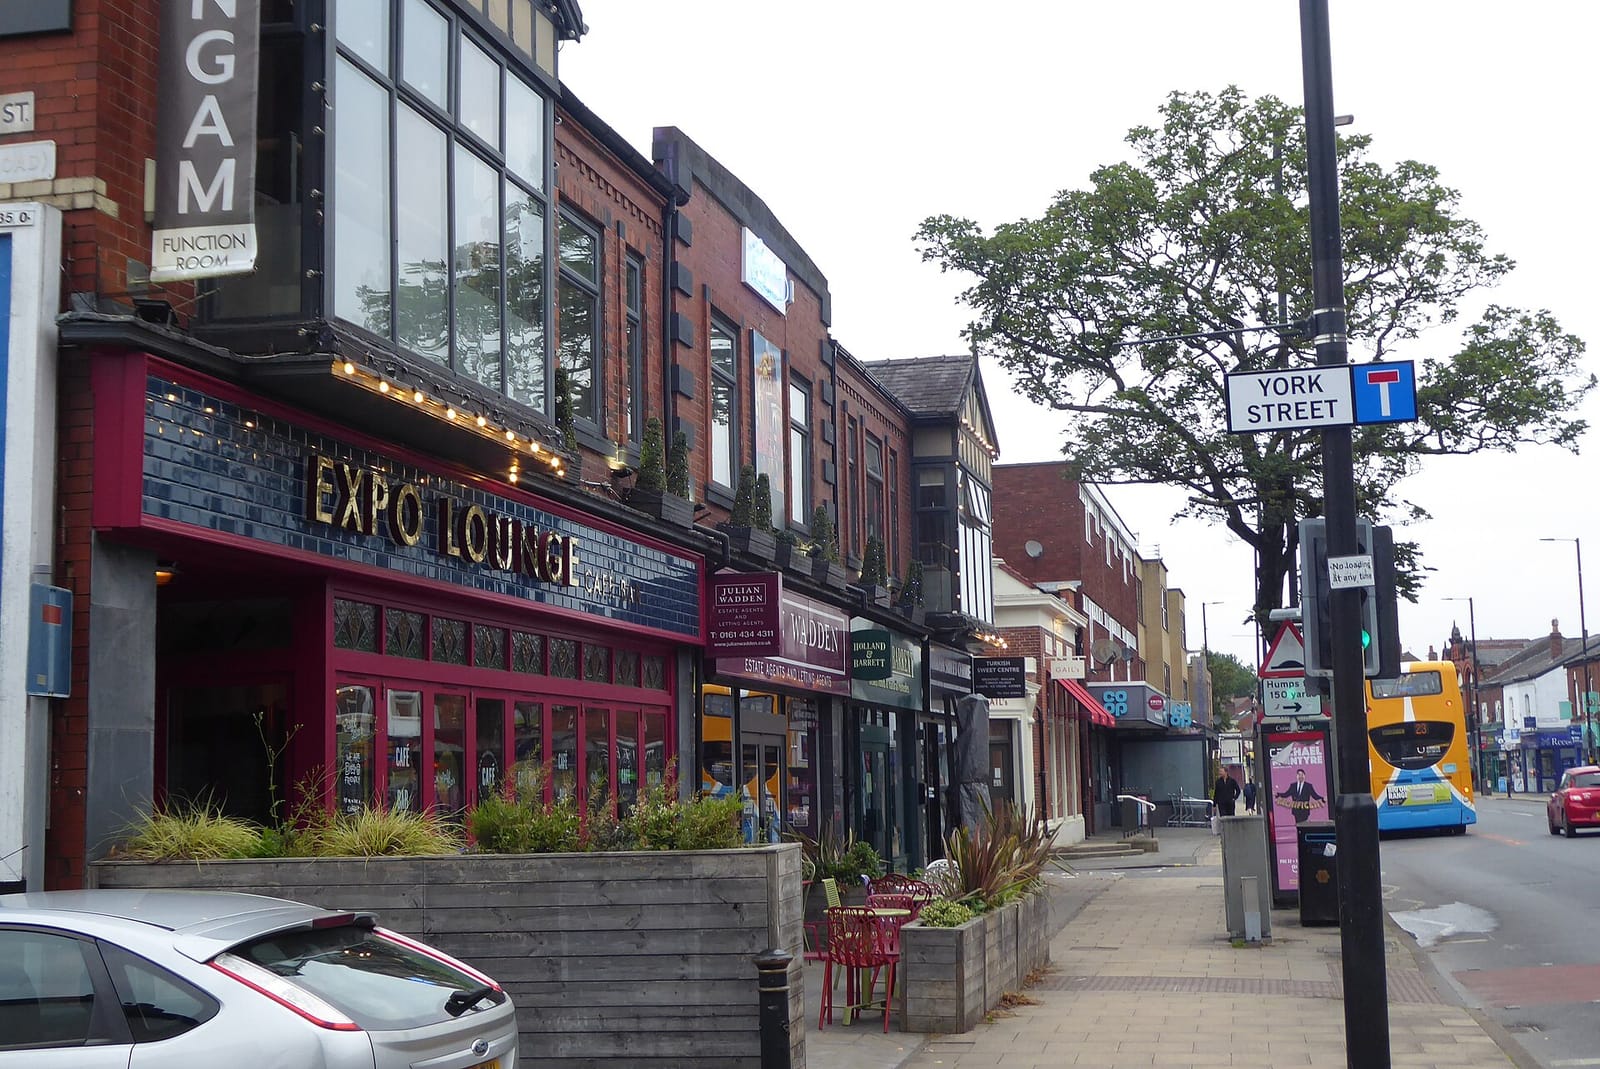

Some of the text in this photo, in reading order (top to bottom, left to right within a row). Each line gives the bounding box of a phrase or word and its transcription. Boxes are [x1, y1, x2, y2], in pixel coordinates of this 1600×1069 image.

[2, 102, 30, 123] ST.
[162, 233, 246, 252] FUNCTION
[176, 254, 229, 270] ROOM
[1257, 373, 1325, 397] YORK
[1247, 399, 1338, 424] STREET
[308, 454, 422, 546] EXPO
[439, 497, 579, 587] LOUNGE
[1332, 562, 1344, 570] No
[719, 595, 763, 603] WADDEN
[722, 586, 760, 596] JULIAN
[719, 631, 737, 639] 0161
[756, 630, 774, 638] 4311
[790, 612, 839, 653] WADDEN
[853, 642, 886, 651] HOLLAND
[866, 650, 873, 659] &
[853, 658, 886, 668] BARRETT
[745, 658, 764, 674] ESTATE
[766, 663, 785, 678] AGENTS
[787, 667, 798, 681] AND
[816, 674, 832, 688] AGENTS
[1267, 680, 1300, 688] Humps
[1270, 691, 1288, 699] 150
[395, 743, 410, 767] CAFÉ
[482, 762, 496, 786] CAFÉ
